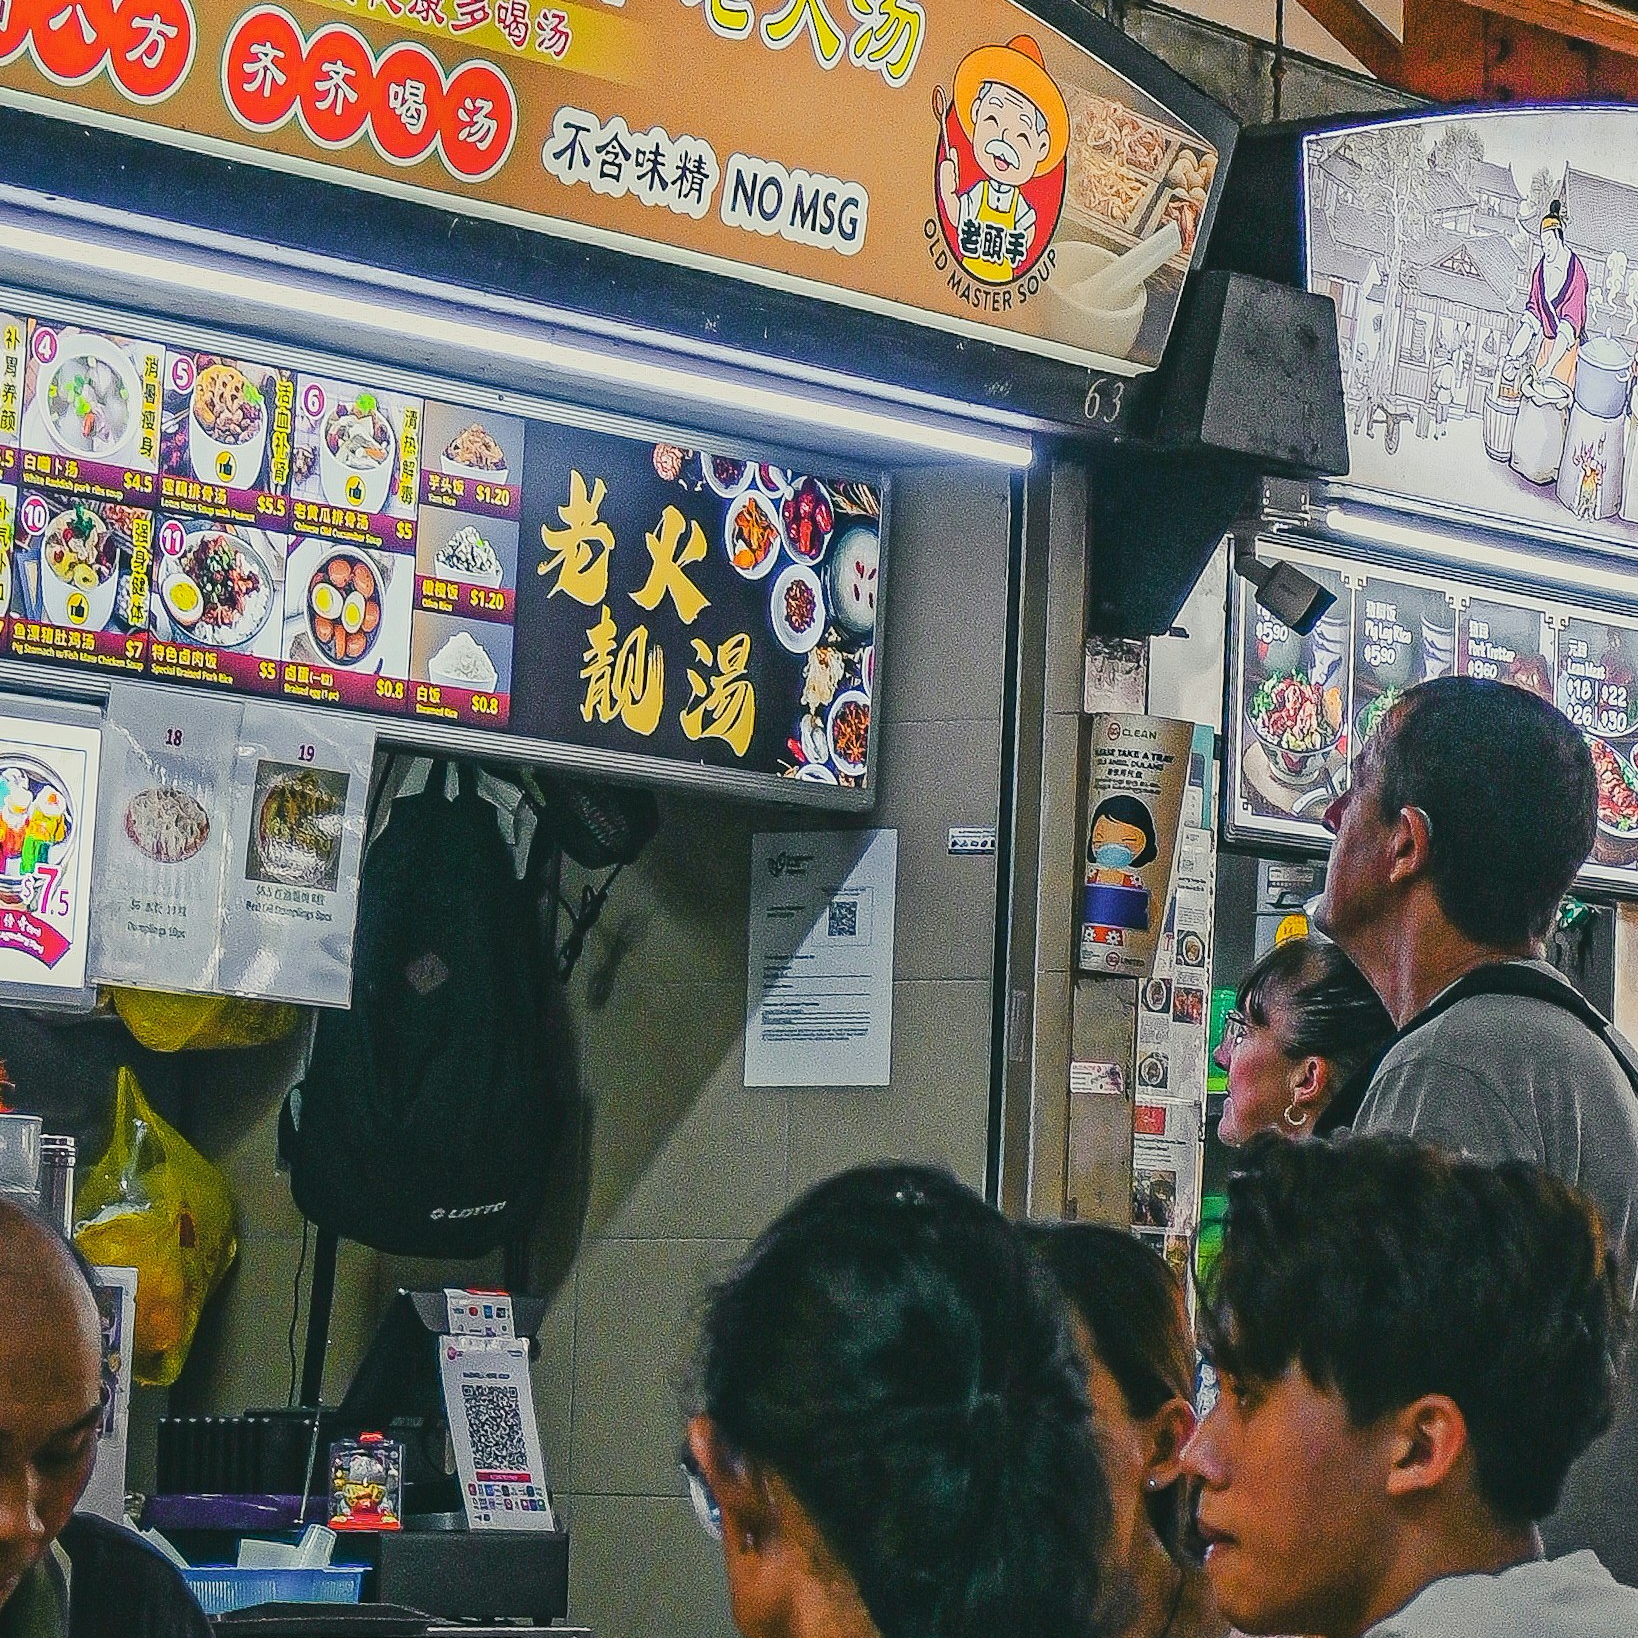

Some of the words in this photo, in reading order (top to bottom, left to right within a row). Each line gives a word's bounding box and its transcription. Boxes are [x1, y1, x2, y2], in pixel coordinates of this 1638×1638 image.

[241, 41, 498, 152] 齐齐喝汤
[553, 123, 710, 202] 不含味精
[733, 170, 783, 224] NO
[792, 183, 859, 241] MSG
[961, 219, 1027, 265] 老頭手
[924, 219, 948, 271] OLD
[947, 270, 1012, 311] MASTER
[1019, 249, 1057, 303] SOUP
[38, 335, 52, 359] 4
[177, 364, 189, 385] 5
[308, 391, 320, 412] 6
[1085, 378, 1125, 422] 63
[124, 471, 153, 493] $4.5
[257, 495, 286, 516] $5.5
[476, 484, 510, 507] $1.20
[26, 505, 44, 528] 10
[163, 527, 184, 549] 11
[396, 521, 413, 539] $5
[470, 589, 504, 610] $1.20
[125, 640, 143, 658] $7
[98, 655, 125, 667] Chicken
[259, 661, 276, 679] $5
[376, 678, 404, 699] $0.8
[472, 694, 498, 715] $0.8
[165, 728, 183, 747] 18
[1122, 729, 1157, 740] CLEAN
[298, 745, 315, 762] 19
[1118, 748, 1139, 758] TAKE
